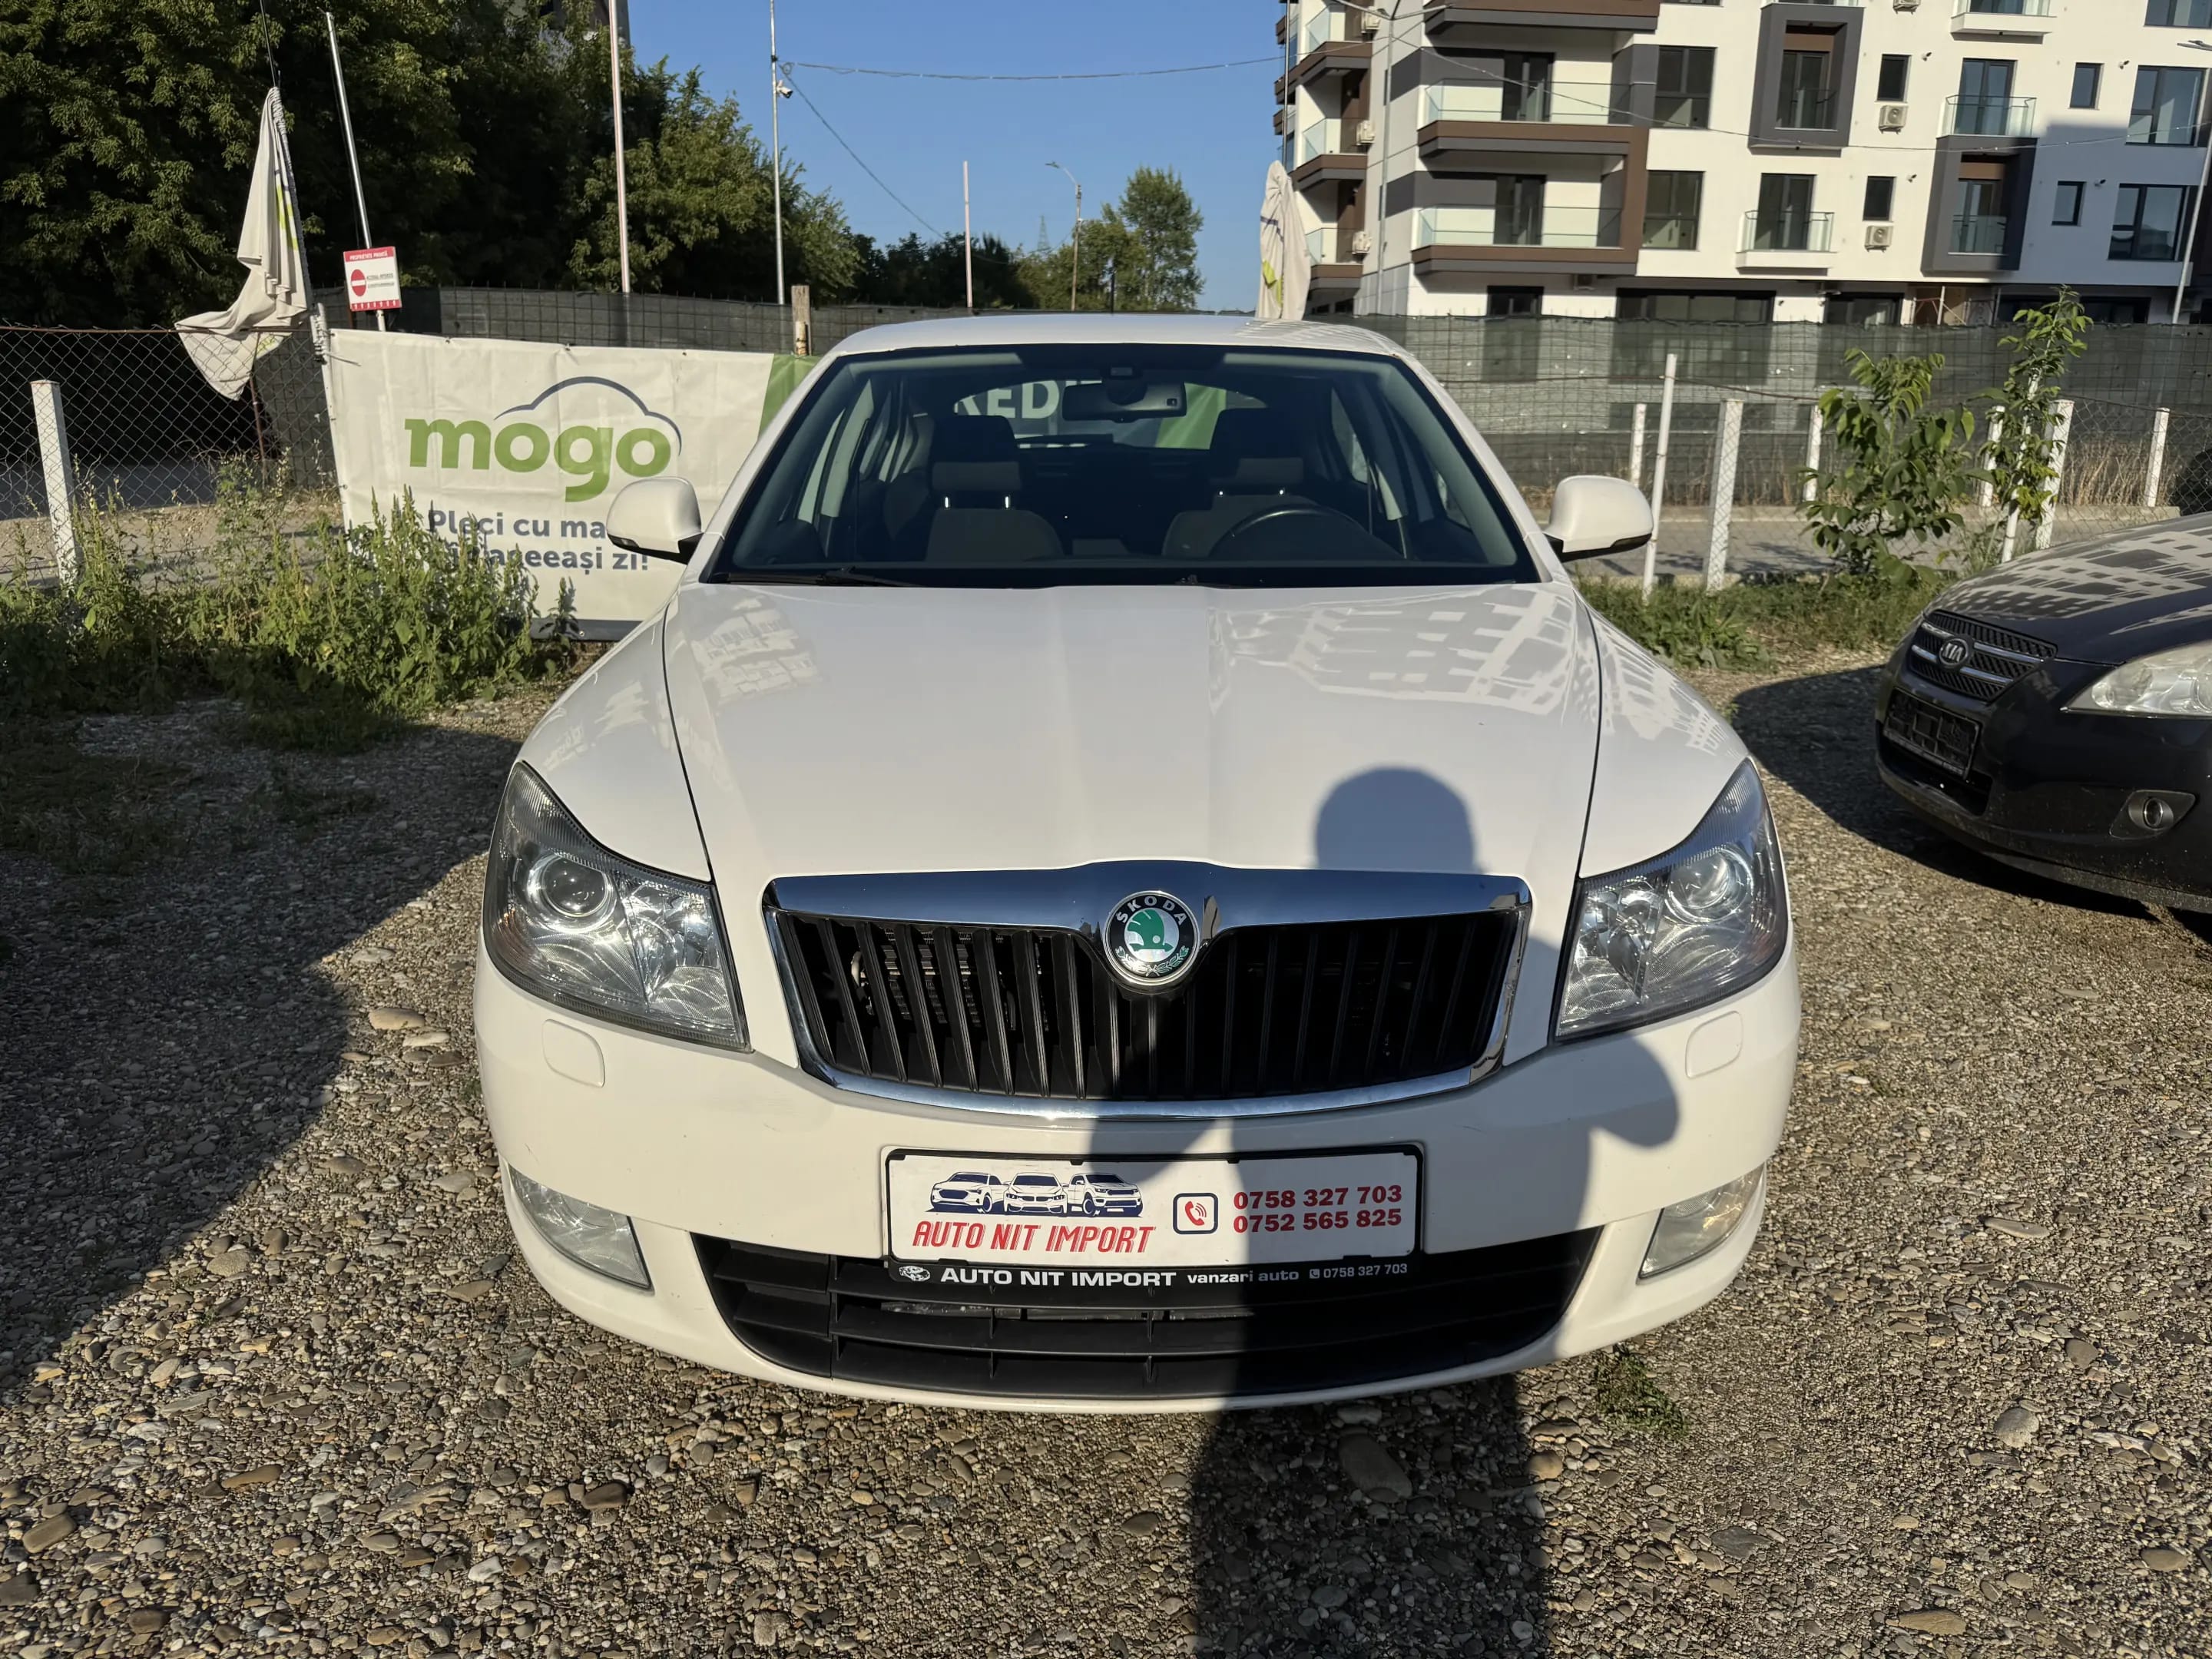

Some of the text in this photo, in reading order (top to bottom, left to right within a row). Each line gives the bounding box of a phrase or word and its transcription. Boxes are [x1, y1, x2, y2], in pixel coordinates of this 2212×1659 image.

[404, 418, 671, 502] mogo
[513, 518, 550, 537] cu
[560, 519, 606, 538] ma
[1233, 1185, 1402, 1210] 0758 327 703
[1233, 1208, 1402, 1233] 0752 565 825
[912, 1220, 1156, 1253] AUTO NIT IMPORT
[941, 1263, 1408, 1287] AUTO NIT IMPORT vanzari auto 0758 327 703
